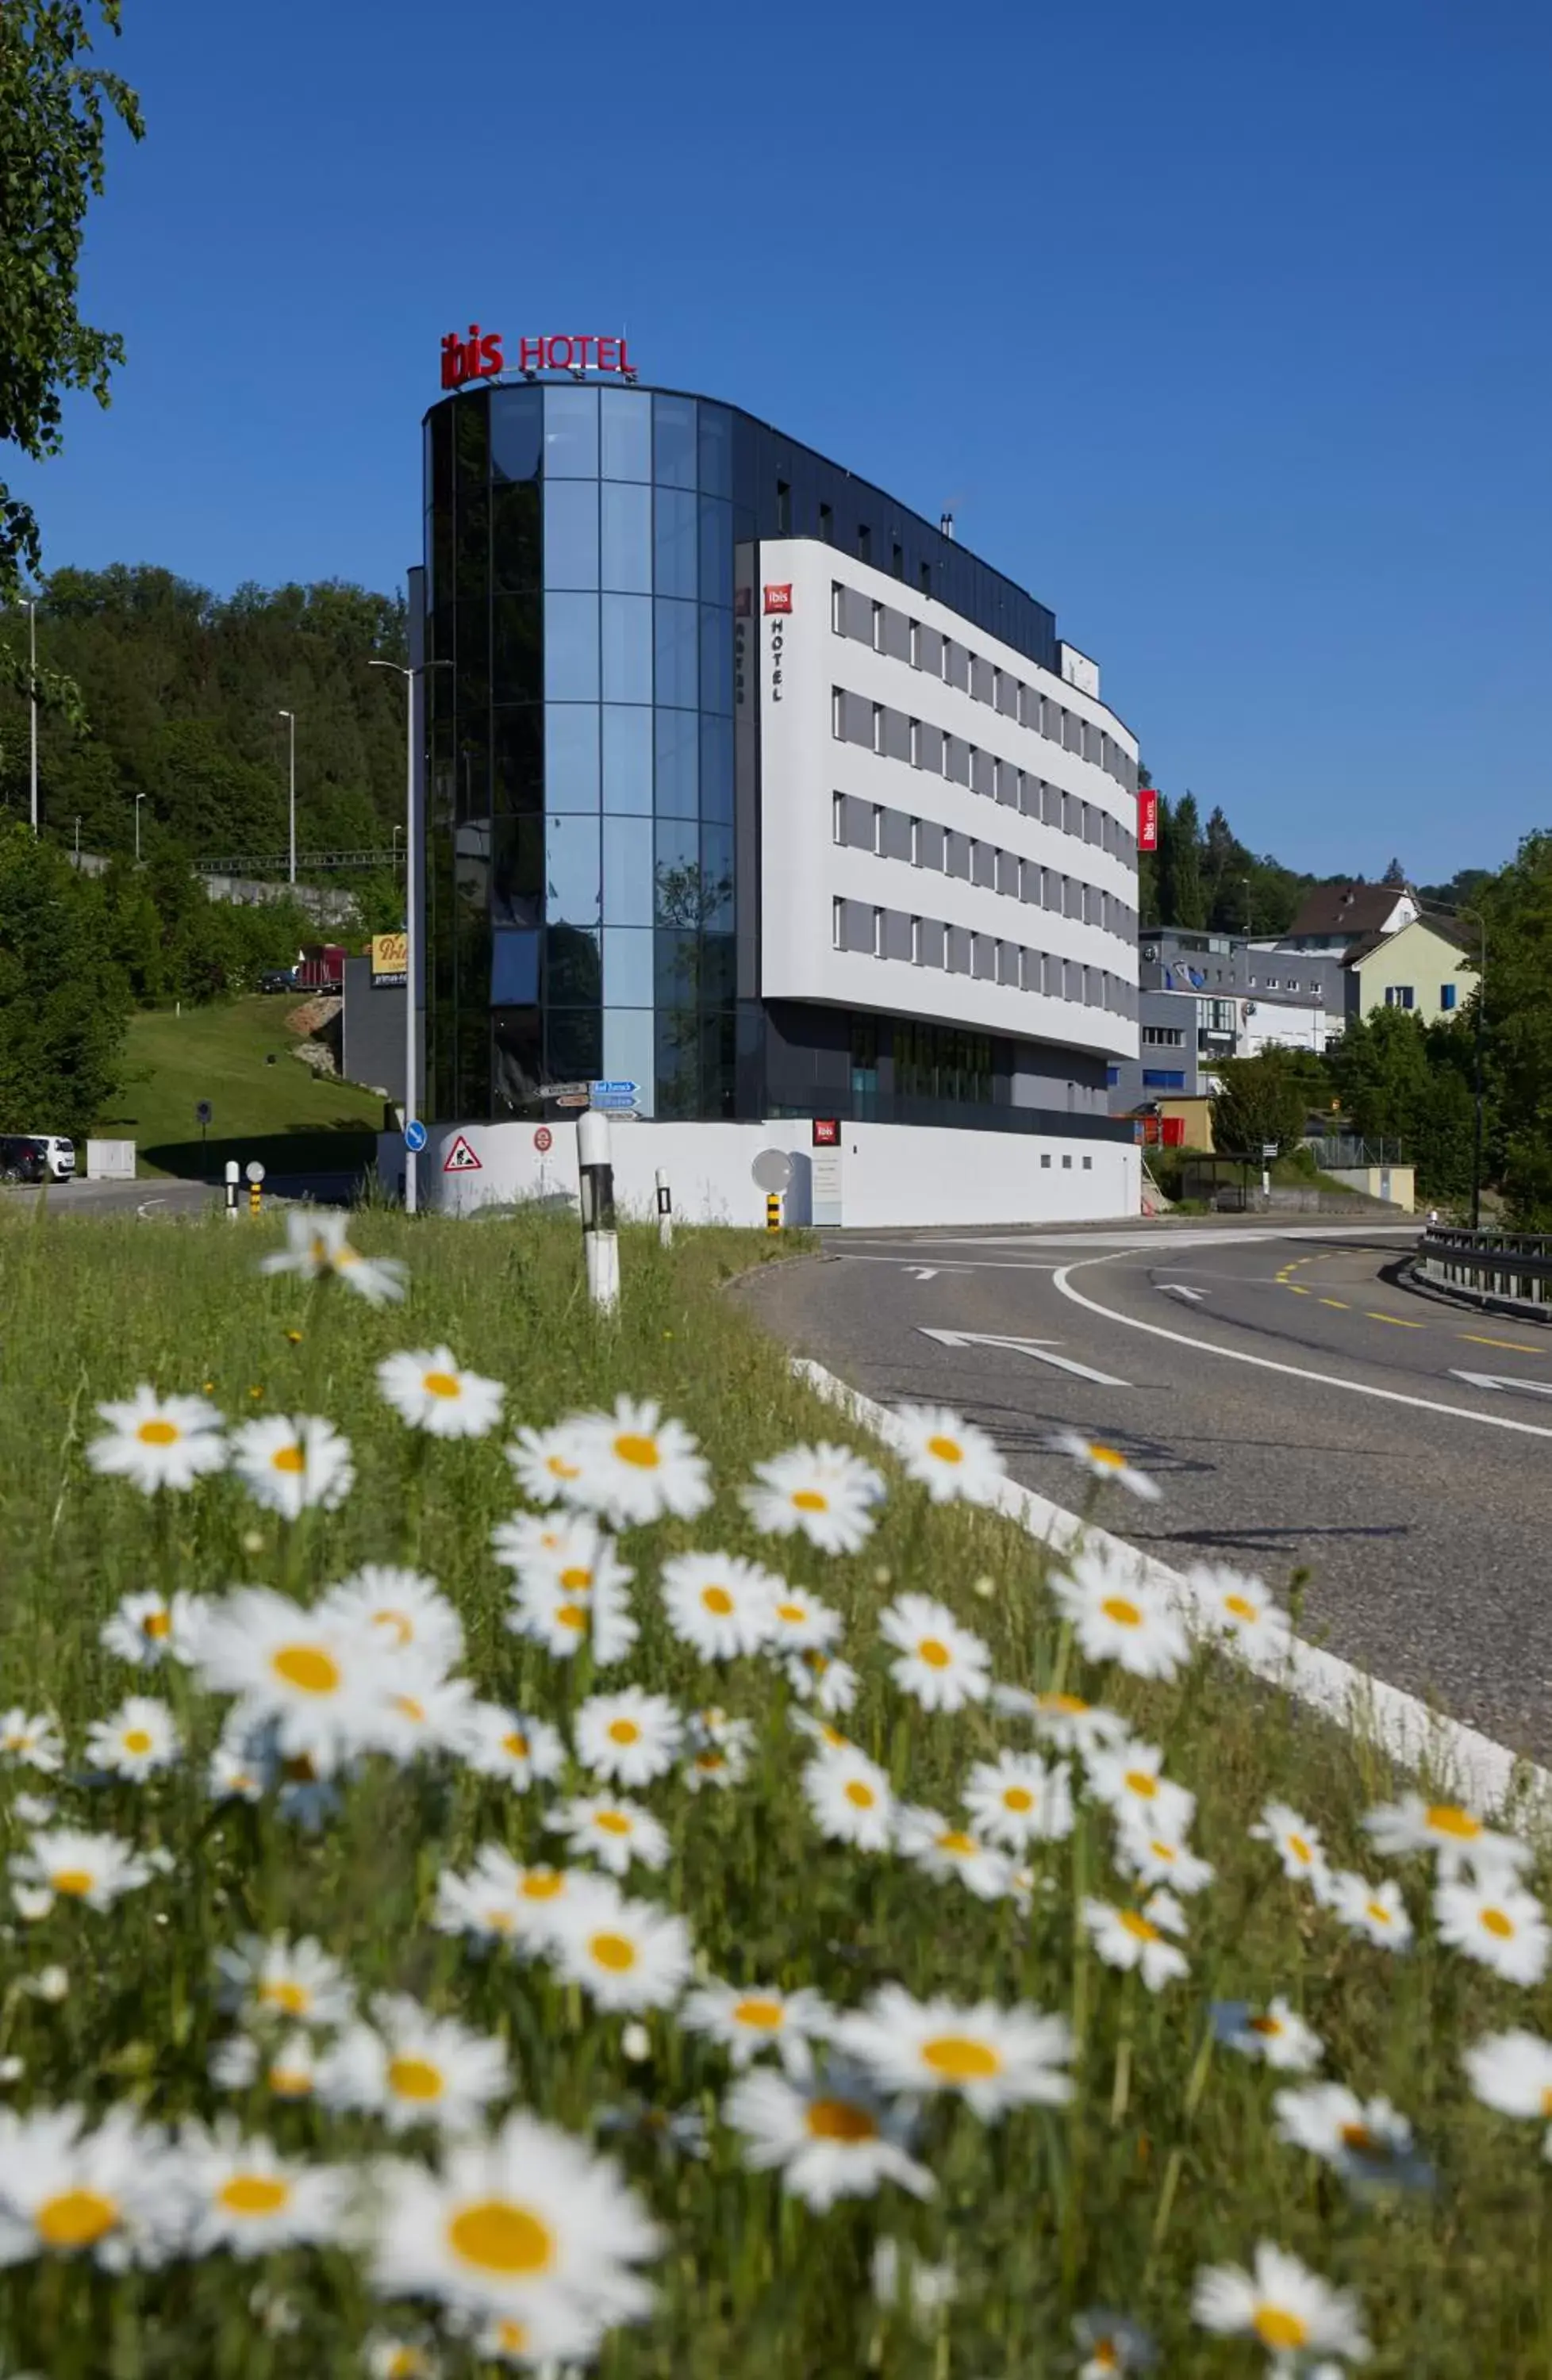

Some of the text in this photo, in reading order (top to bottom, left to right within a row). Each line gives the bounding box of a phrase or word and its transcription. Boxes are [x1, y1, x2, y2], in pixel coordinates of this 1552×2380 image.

[441, 324, 638, 390] ibis HOTEL
[769, 591, 788, 602] ibis
[771, 619, 783, 702] HOTEL
